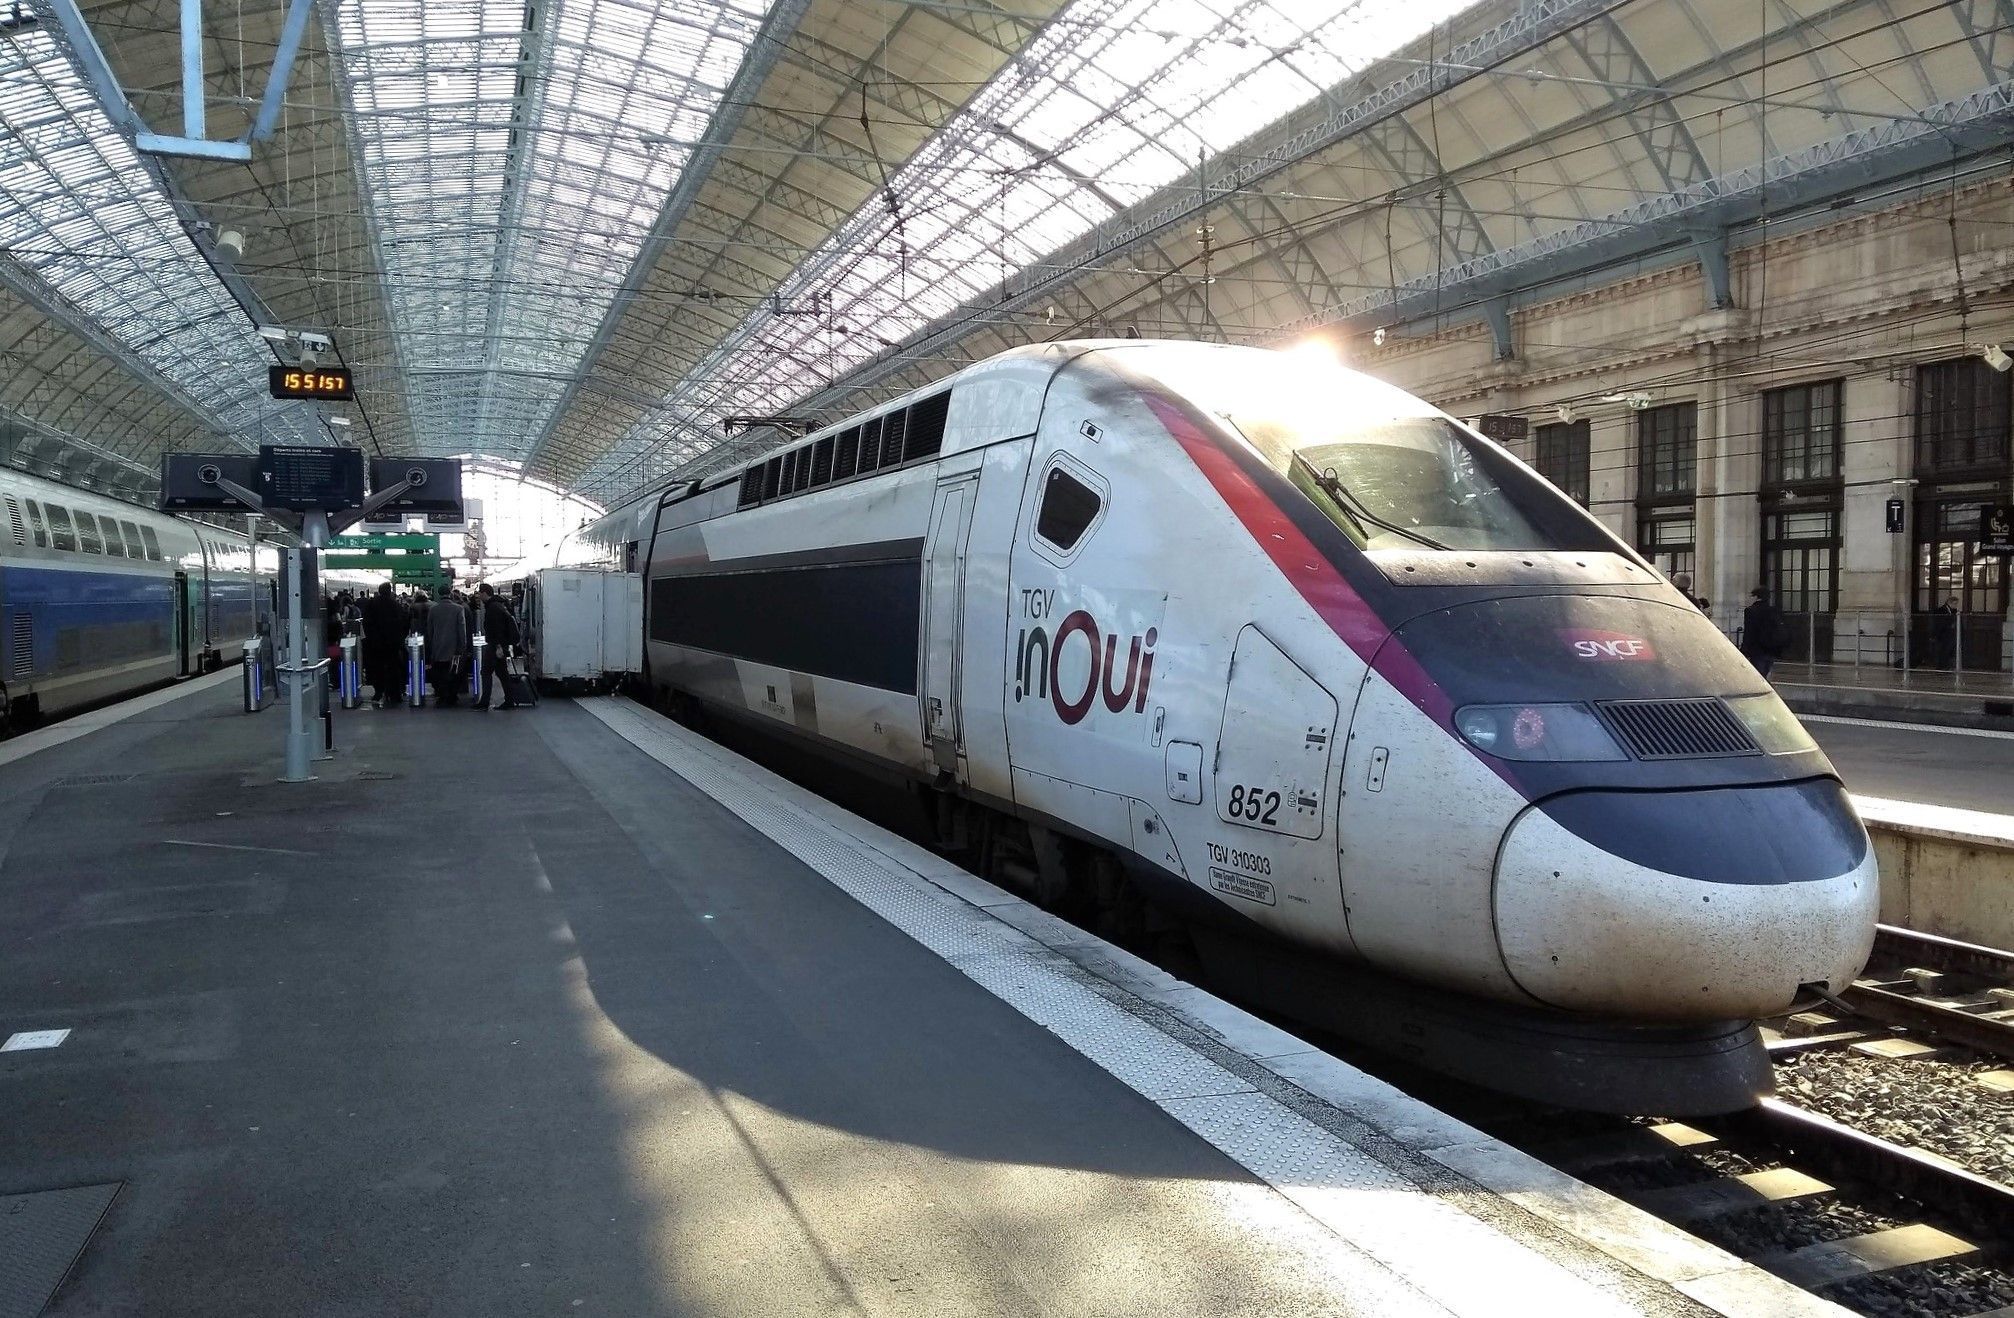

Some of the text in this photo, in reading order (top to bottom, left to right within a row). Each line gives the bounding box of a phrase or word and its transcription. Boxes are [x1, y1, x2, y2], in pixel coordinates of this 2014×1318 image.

[1022, 588, 1055, 619] TGV
[1574, 640, 1644, 657] SNCF
[1228, 784, 1281, 826] 852
[1206, 842, 1271, 875] TGV 310303
